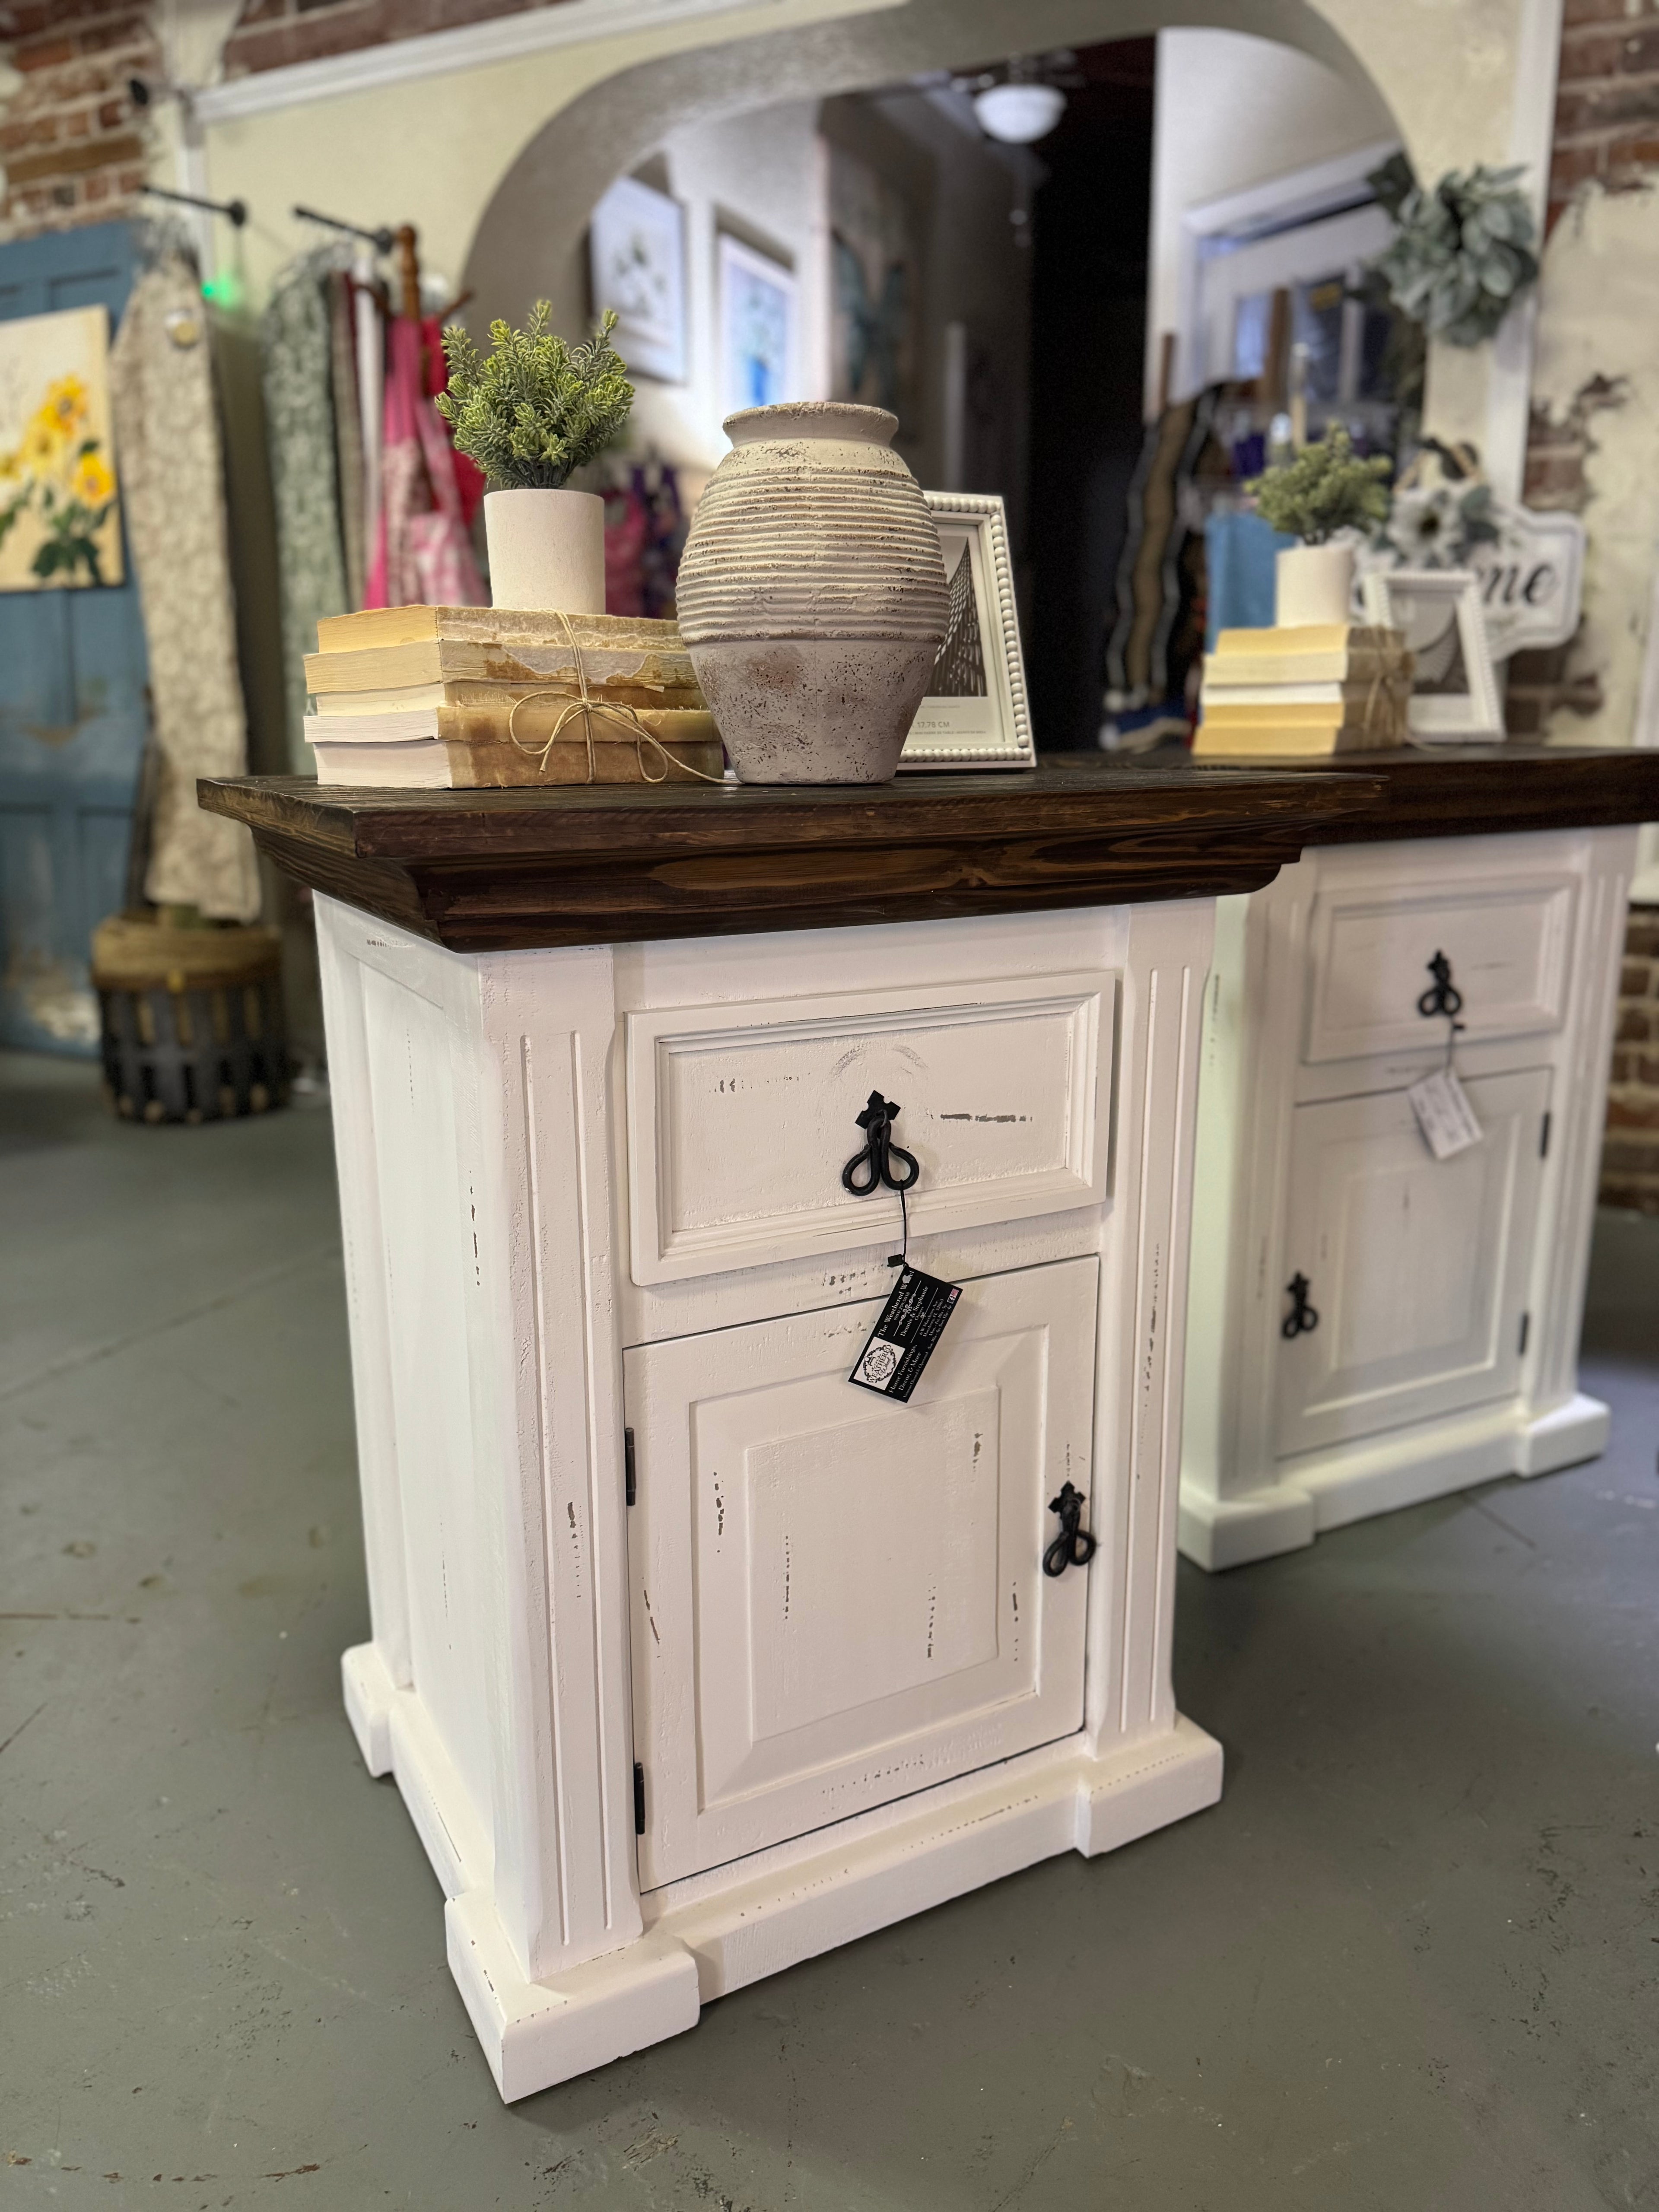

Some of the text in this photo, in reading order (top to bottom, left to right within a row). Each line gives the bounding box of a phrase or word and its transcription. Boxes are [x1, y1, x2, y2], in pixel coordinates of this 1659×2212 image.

[877, 1270, 914, 1336] The Weathered Wel
[900, 1319, 912, 1336] Dennis
[912, 1286, 928, 1311] Stephanie
[935, 1299, 944, 1310] 32063
[868, 1344, 891, 1382] WEATHERED
[888, 1344, 917, 1392] Home Furnishings,
[898, 1374, 911, 1390] Decor,
[910, 1352, 921, 1367] More
